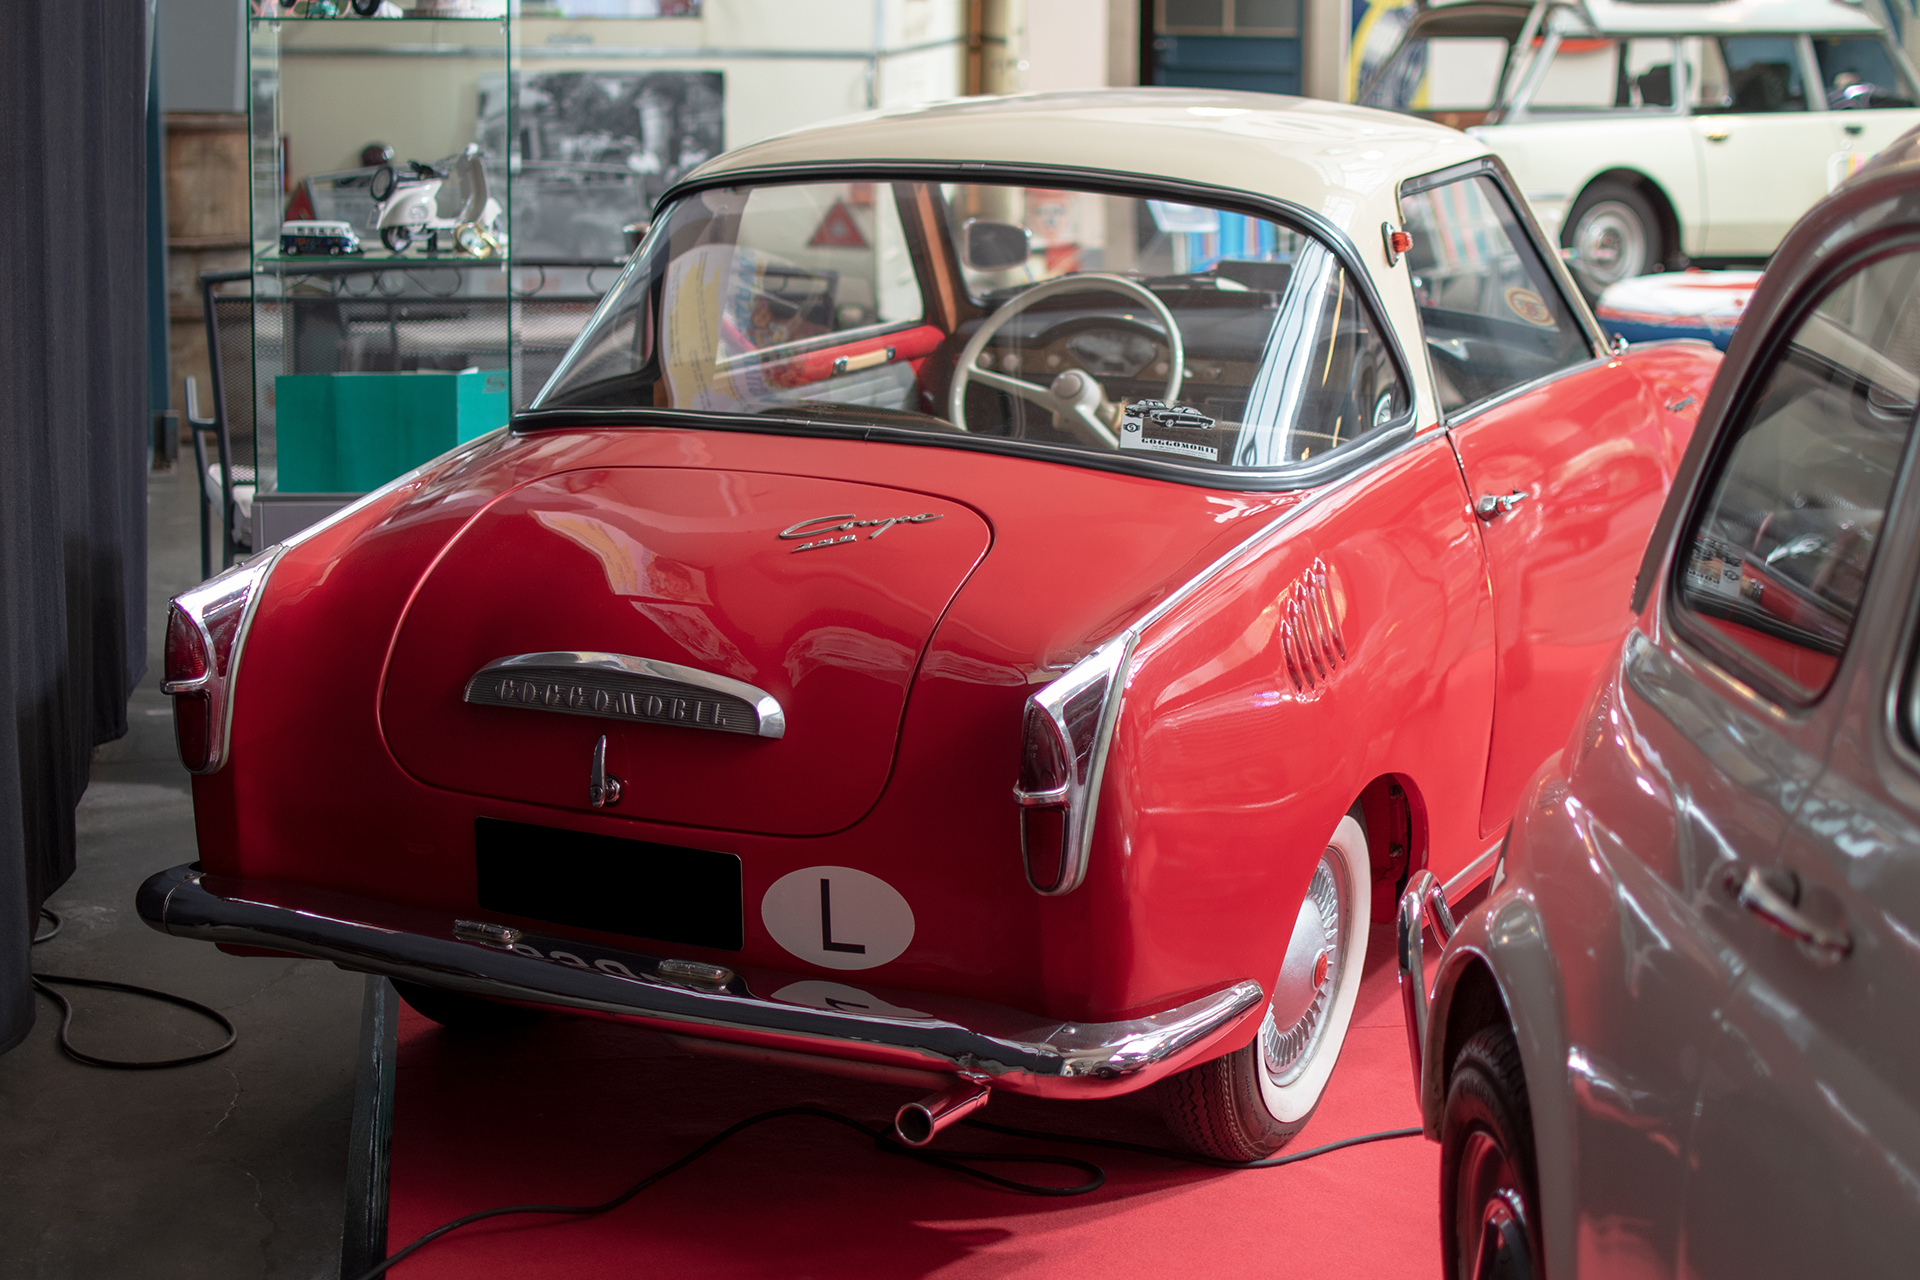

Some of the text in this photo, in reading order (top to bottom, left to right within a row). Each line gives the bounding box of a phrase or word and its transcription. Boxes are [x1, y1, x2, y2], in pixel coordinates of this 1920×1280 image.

[1141, 437, 1217, 455] GOGGOMOBIL
[494, 678, 727, 726] GOGGOMOBIL
[819, 878, 866, 954] L
